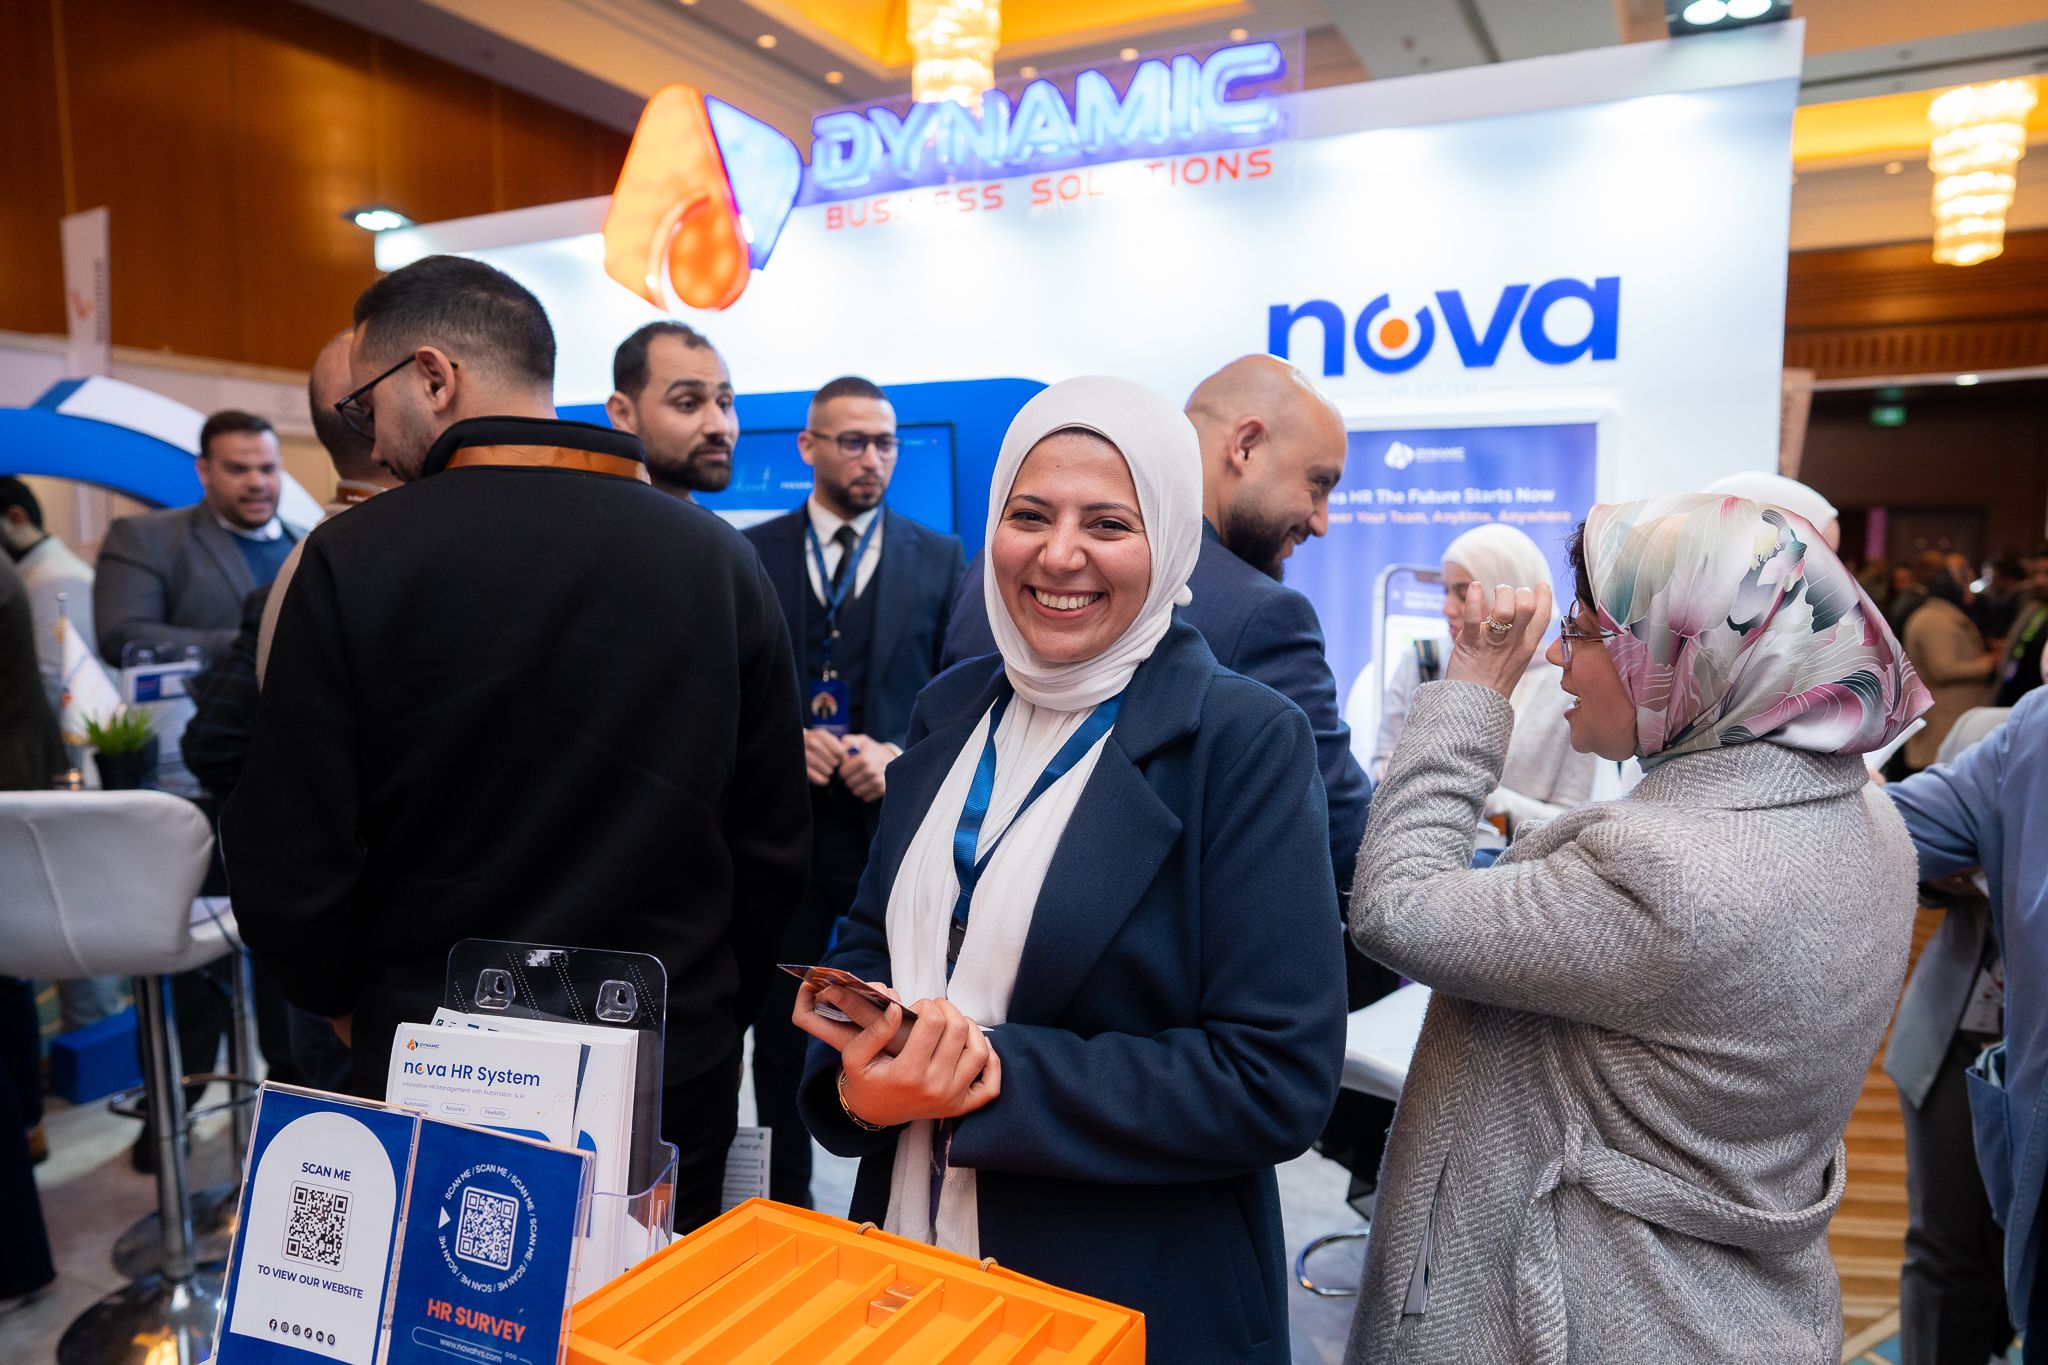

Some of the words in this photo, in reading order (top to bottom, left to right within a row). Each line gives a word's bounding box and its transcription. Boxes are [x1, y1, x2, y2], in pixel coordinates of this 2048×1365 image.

[812, 41, 1285, 189] DYNAMIC
[1031, 148, 1273, 206] SOLTIONS
[1269, 276, 1621, 376] nova
[1350, 489, 1373, 504] HR
[1375, 488, 1405, 505] The
[1407, 488, 1461, 505] Future
[1463, 487, 1513, 504] Starts
[1515, 486, 1556, 503] Now
[1357, 511, 1386, 524] Your
[1498, 509, 1572, 525] Anywhere
[451, 1063, 473, 1080] HR
[477, 1066, 540, 1087] System
[436, 1085, 471, 1094] Management
[484, 1089, 513, 1098] Automation
[403, 1100, 430, 1108] Automation
[445, 1104, 466, 1113] Accuracy
[484, 1108, 506, 1118] Flexibility
[301, 1162, 333, 1177] SCAN
[333, 1169, 351, 1182] ME
[460, 1169, 472, 1181] ME
[476, 1164, 496, 1174] SCAN
[497, 1166, 508, 1177] ME
[445, 1177, 462, 1200] SCAN
[511, 1175, 529, 1198] SCAN
[525, 1197, 534, 1211] ME
[529, 1218, 537, 1246] SCAN
[439, 1235, 447, 1249] ME
[443, 1249, 458, 1274] SCAN
[524, 1246, 534, 1261] ME
[257, 1265, 270, 1276] TO
[272, 1268, 298, 1283] VIEW
[299, 1274, 320, 1288] OUR
[322, 1279, 364, 1299] WEBSITE
[460, 1275, 472, 1286] ME
[508, 1264, 526, 1285] SCAN
[471, 1281, 492, 1292] SCAN
[497, 1281, 508, 1291] ME
[426, 1298, 453, 1323] HR
[454, 1306, 527, 1343] SURVEY
